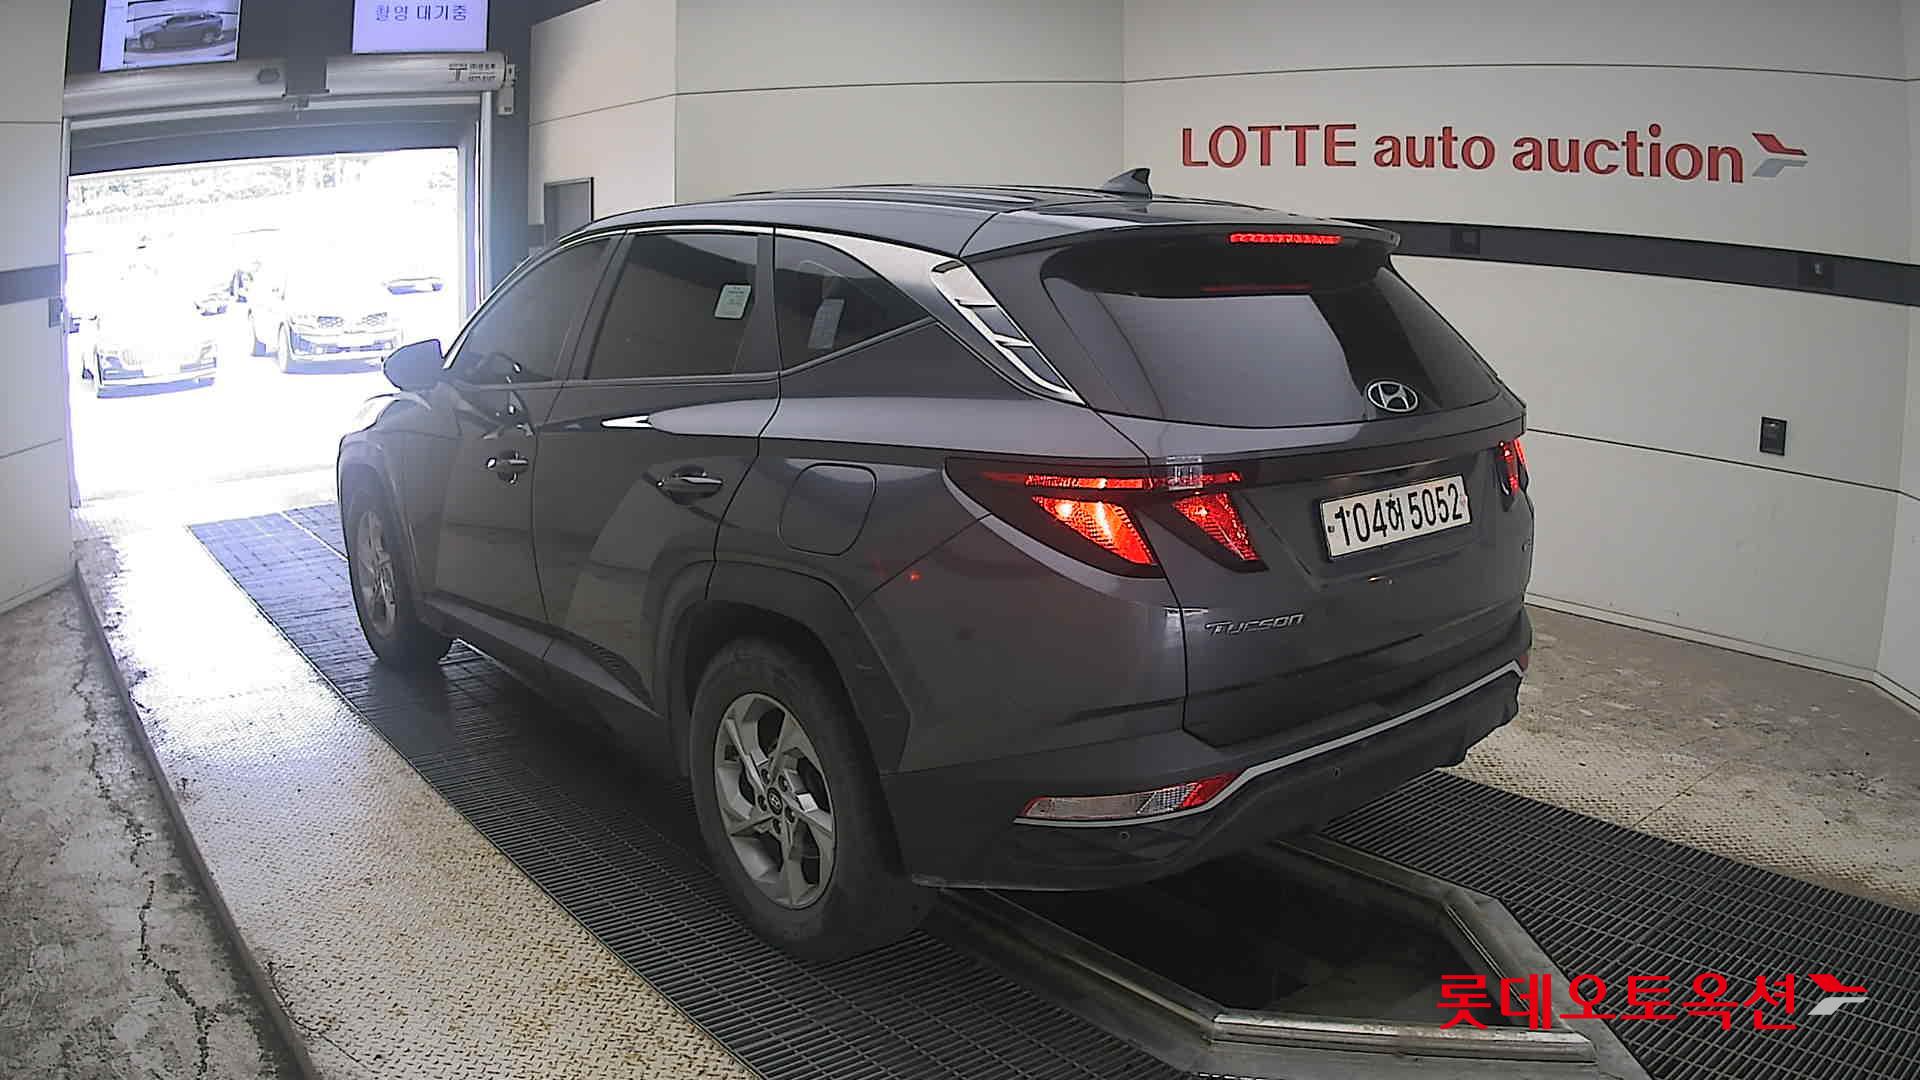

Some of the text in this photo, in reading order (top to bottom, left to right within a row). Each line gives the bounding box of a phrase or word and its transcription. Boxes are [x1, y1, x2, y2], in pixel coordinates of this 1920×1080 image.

[416, 4, 467, 21] 대기중
[1182, 123, 1744, 184] LOTTE auto auction
[1408, 483, 1463, 530] 5052
